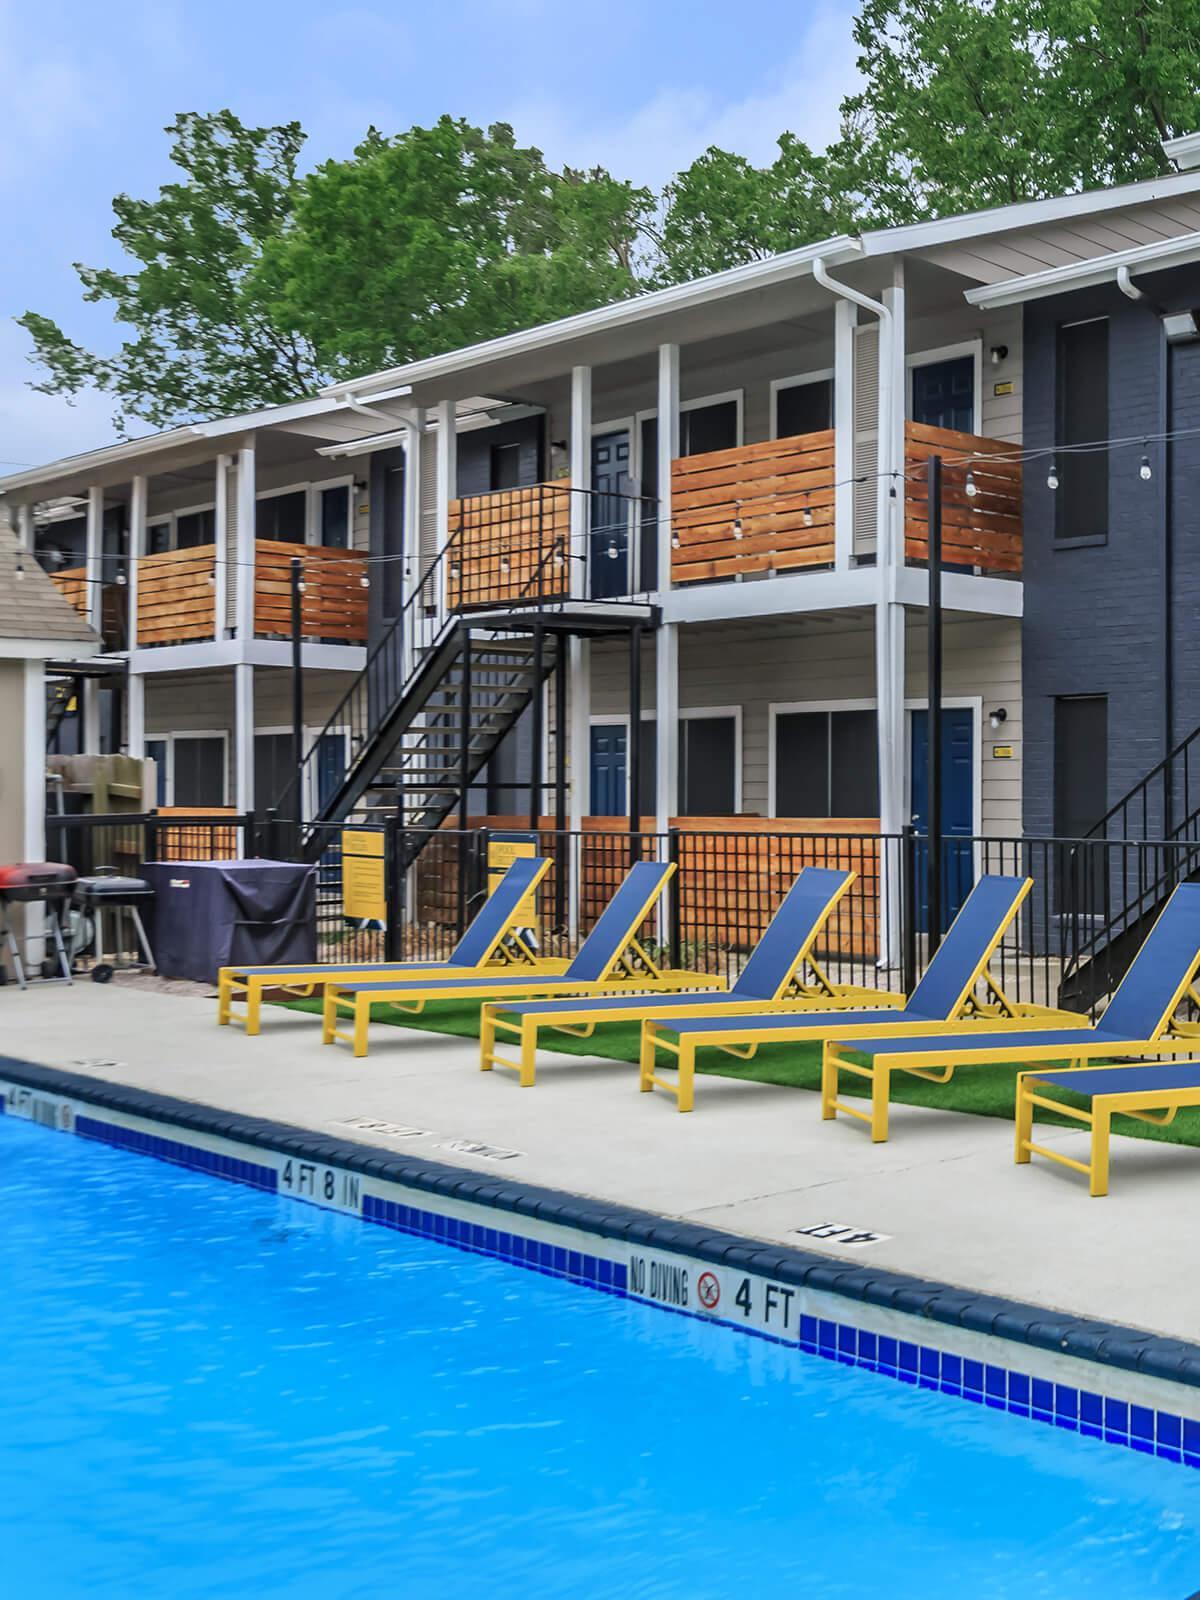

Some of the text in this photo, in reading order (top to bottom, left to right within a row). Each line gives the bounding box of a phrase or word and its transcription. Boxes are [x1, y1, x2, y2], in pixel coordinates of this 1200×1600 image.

[282, 1160, 360, 1208] 4 FT 8 IN
[795, 1223, 880, 1243] 4 FT
[630, 1255, 795, 1329] NO DIVING 4 FT
